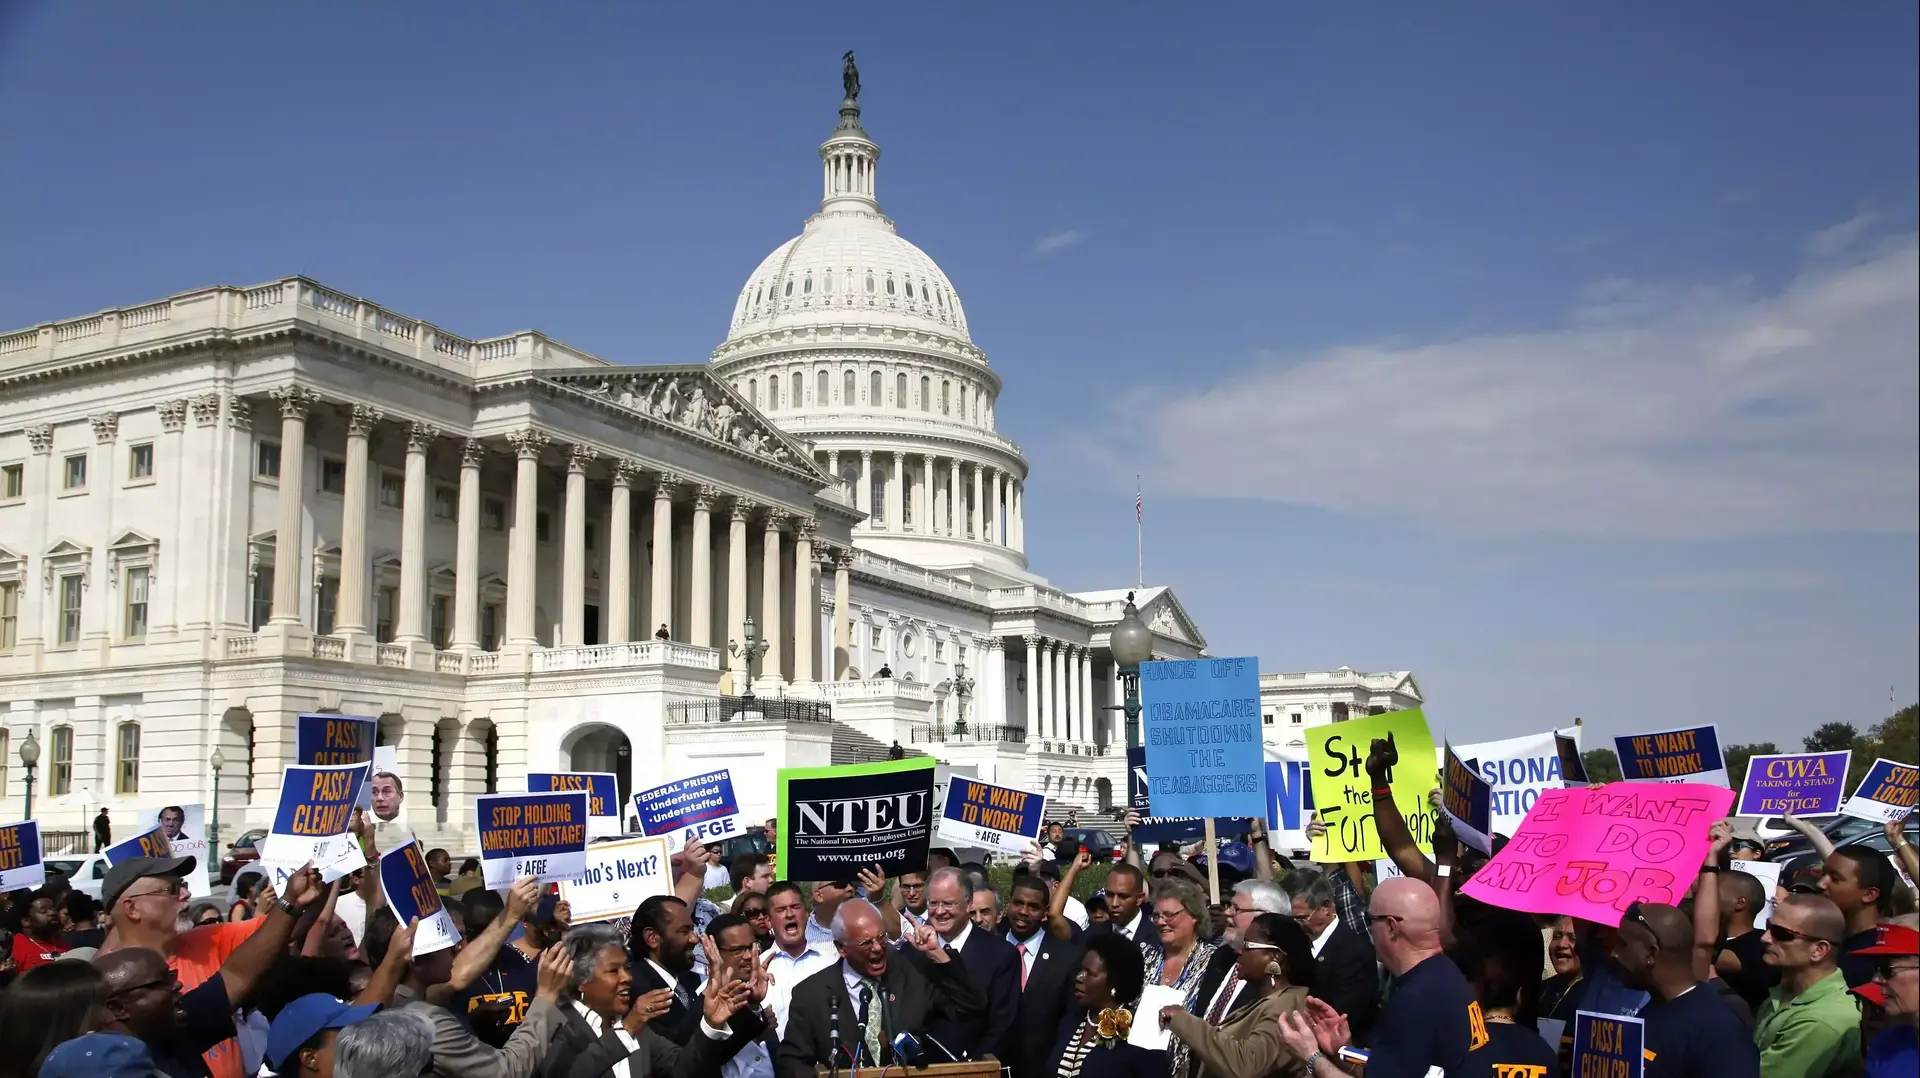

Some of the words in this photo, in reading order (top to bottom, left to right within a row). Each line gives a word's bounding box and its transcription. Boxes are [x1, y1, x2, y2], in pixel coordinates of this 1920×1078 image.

[1144, 660, 1197, 681] HANDS
[1210, 657, 1246, 679] OFF
[1150, 699, 1256, 721] OBAMACARE
[326, 720, 357, 748] PASS
[1150, 723, 1252, 746] SHUTDOWN
[1632, 736, 1654, 756] WE
[1655, 731, 1696, 753] WANT
[1188, 748, 1225, 768] THE
[1482, 755, 1563, 785] SIONA
[1636, 759, 1654, 777] TO
[1655, 753, 1703, 776] WORK!
[1767, 759, 1828, 778] CWA
[311, 771, 345, 801] PASS
[343, 771, 353, 799] A
[551, 776, 582, 792] PASS
[586, 776, 594, 794] A
[636, 785, 681, 804] FEDERAL
[683, 772, 728, 789] PRISONS
[1149, 773, 1258, 795] TEABAGGERS
[1804, 778, 1834, 786] STAND
[650, 785, 719, 811] Underfunded
[967, 782, 988, 804] WE
[989, 787, 1028, 812] WANT
[1344, 785, 1371, 805] the
[1491, 787, 1558, 816] ATIO
[1759, 798, 1821, 811] JUSTICE
[1871, 783, 1919, 806] LOCKO
[292, 804, 337, 834] CLEAN
[492, 805, 521, 827] STOP
[524, 803, 571, 825] HOLDING
[653, 797, 723, 822] Understaffed
[795, 792, 927, 835] NTEU
[961, 803, 978, 823] TO
[981, 807, 1024, 833] WORK!
[1533, 796, 1568, 822] I
[1583, 793, 1710, 826] WANT
[0, 827, 20, 848] HE
[482, 828, 530, 851] AMERICA
[533, 824, 585, 847] HOSTAGE!
[685, 818, 735, 841] AFGE
[810, 837, 840, 845] National
[841, 836, 872, 846] Treasury
[872, 831, 907, 843] Employees
[907, 828, 926, 837] Union
[981, 831, 1001, 845] AFGE
[187, 840, 205, 850] OUR
[1516, 832, 1568, 858] TO
[1597, 824, 1685, 863] DO
[0, 848, 23, 869] UT!
[524, 859, 547, 875] AFGE
[617, 855, 658, 880] Next?
[817, 849, 906, 863] www.nteu.org
[1476, 862, 1556, 892] MY
[1556, 861, 1675, 912] JOB
[1590, 1019, 1613, 1053] PASS
[1615, 1023, 1622, 1055] A
[1581, 1052, 1609, 1077] CLEAN
